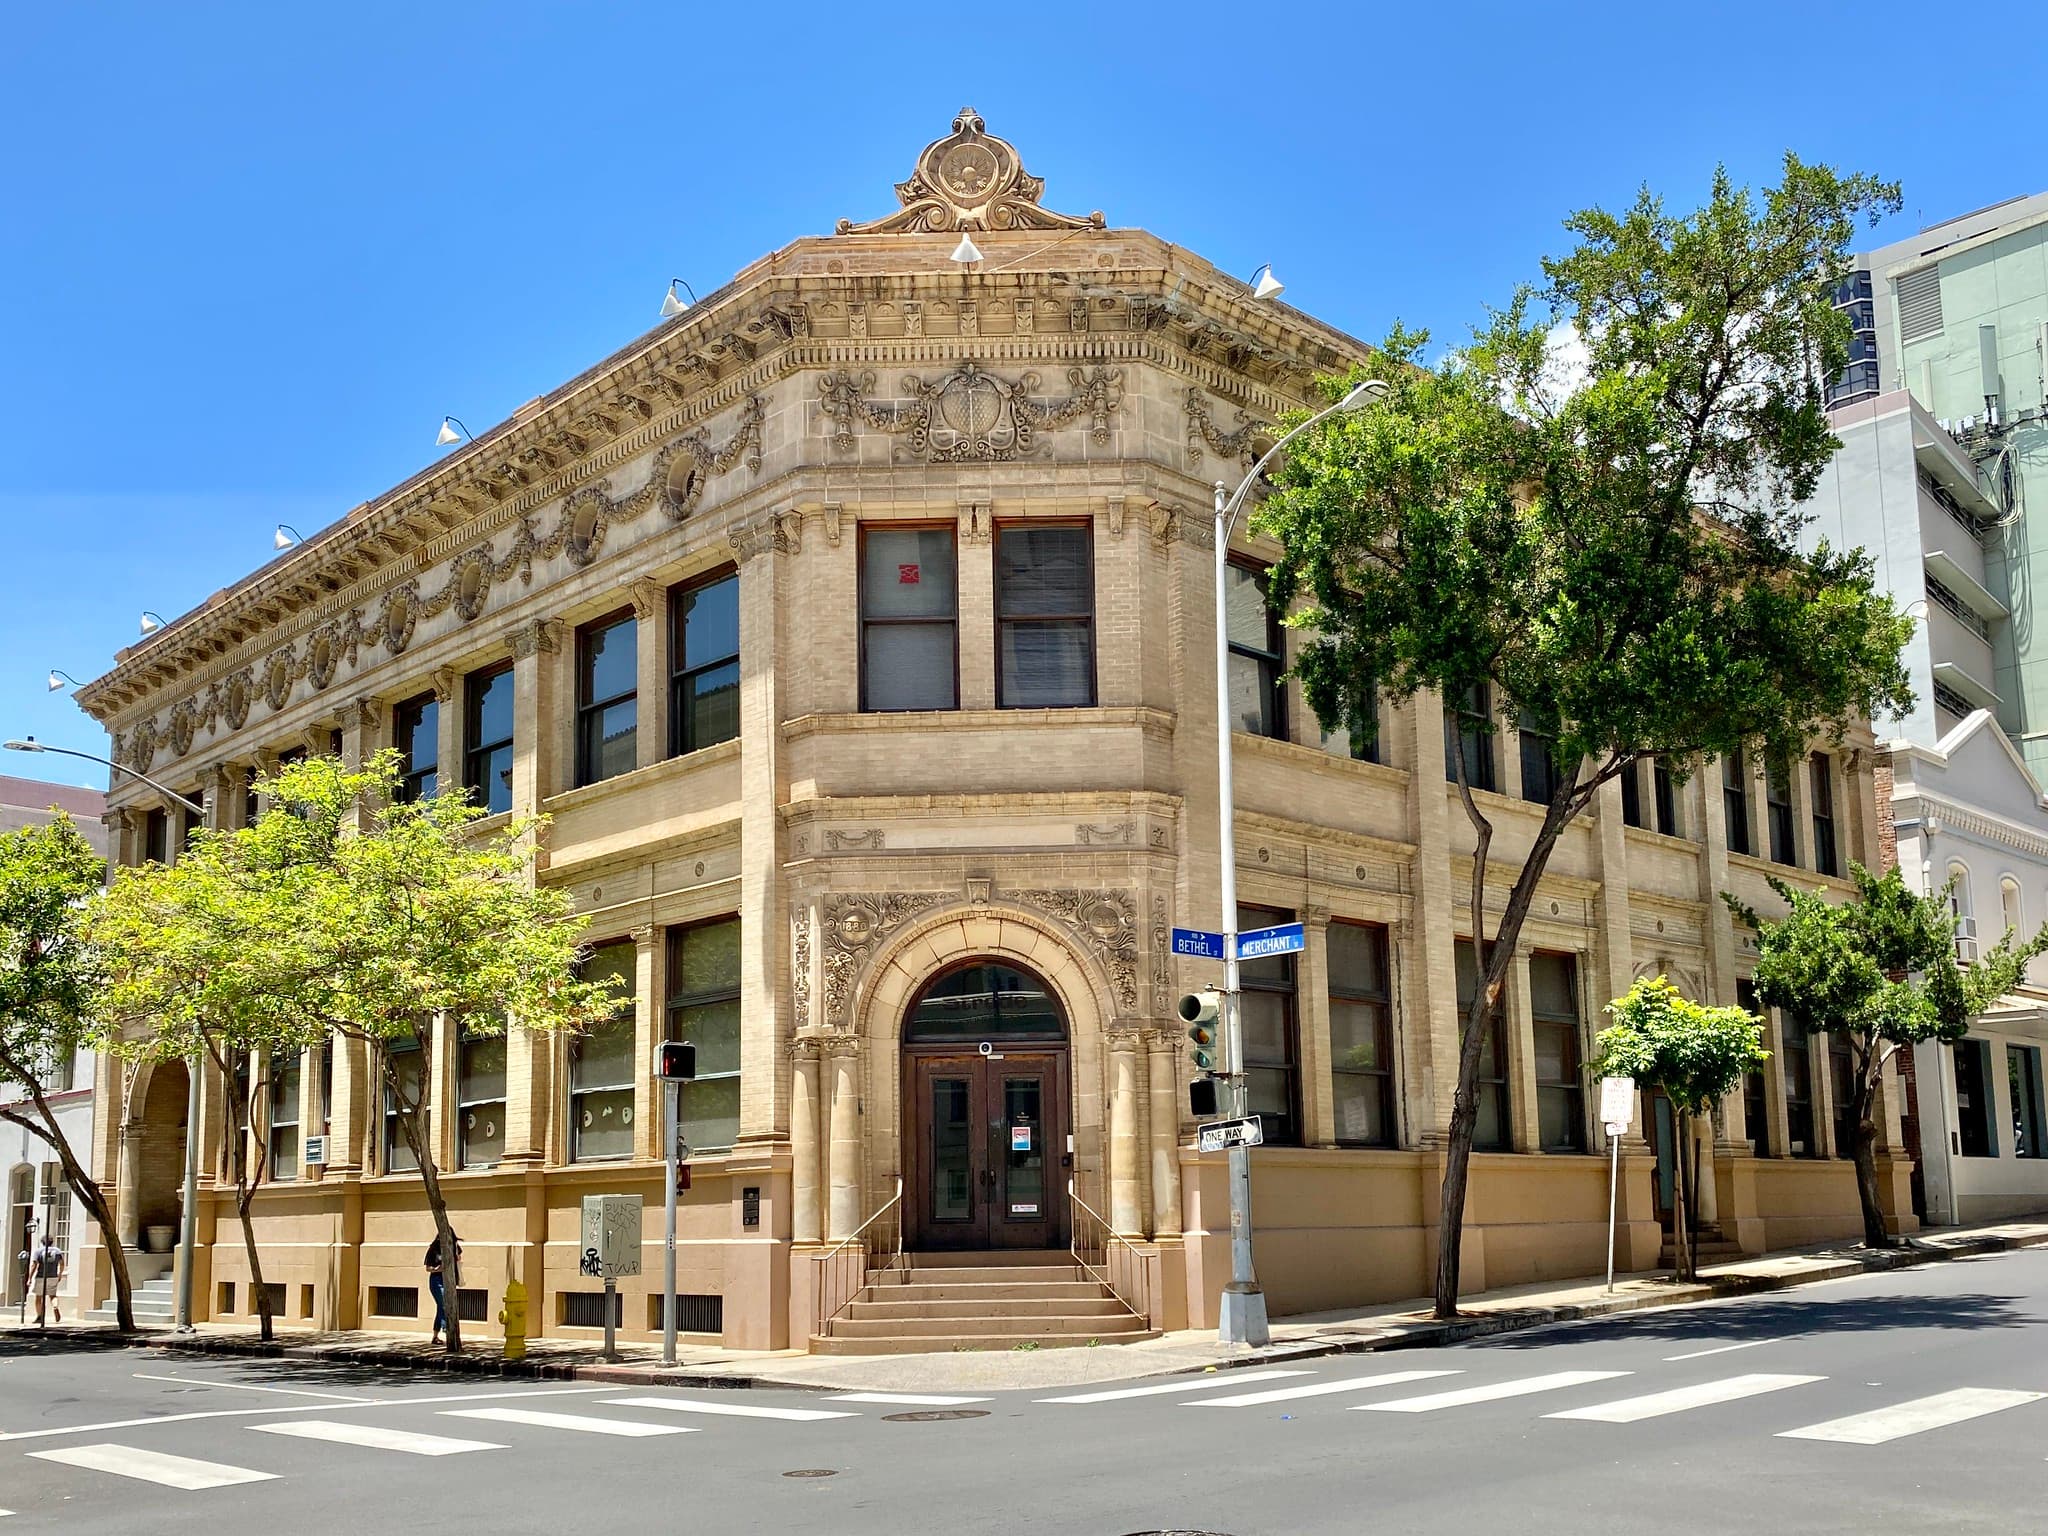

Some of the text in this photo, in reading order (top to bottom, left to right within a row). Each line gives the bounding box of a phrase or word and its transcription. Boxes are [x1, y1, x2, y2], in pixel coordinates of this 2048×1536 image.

[1178, 938, 1212, 955] BETHEL
[1242, 935, 1291, 956] MERCHANT
[1205, 1127, 1243, 1142] ONE WAY
